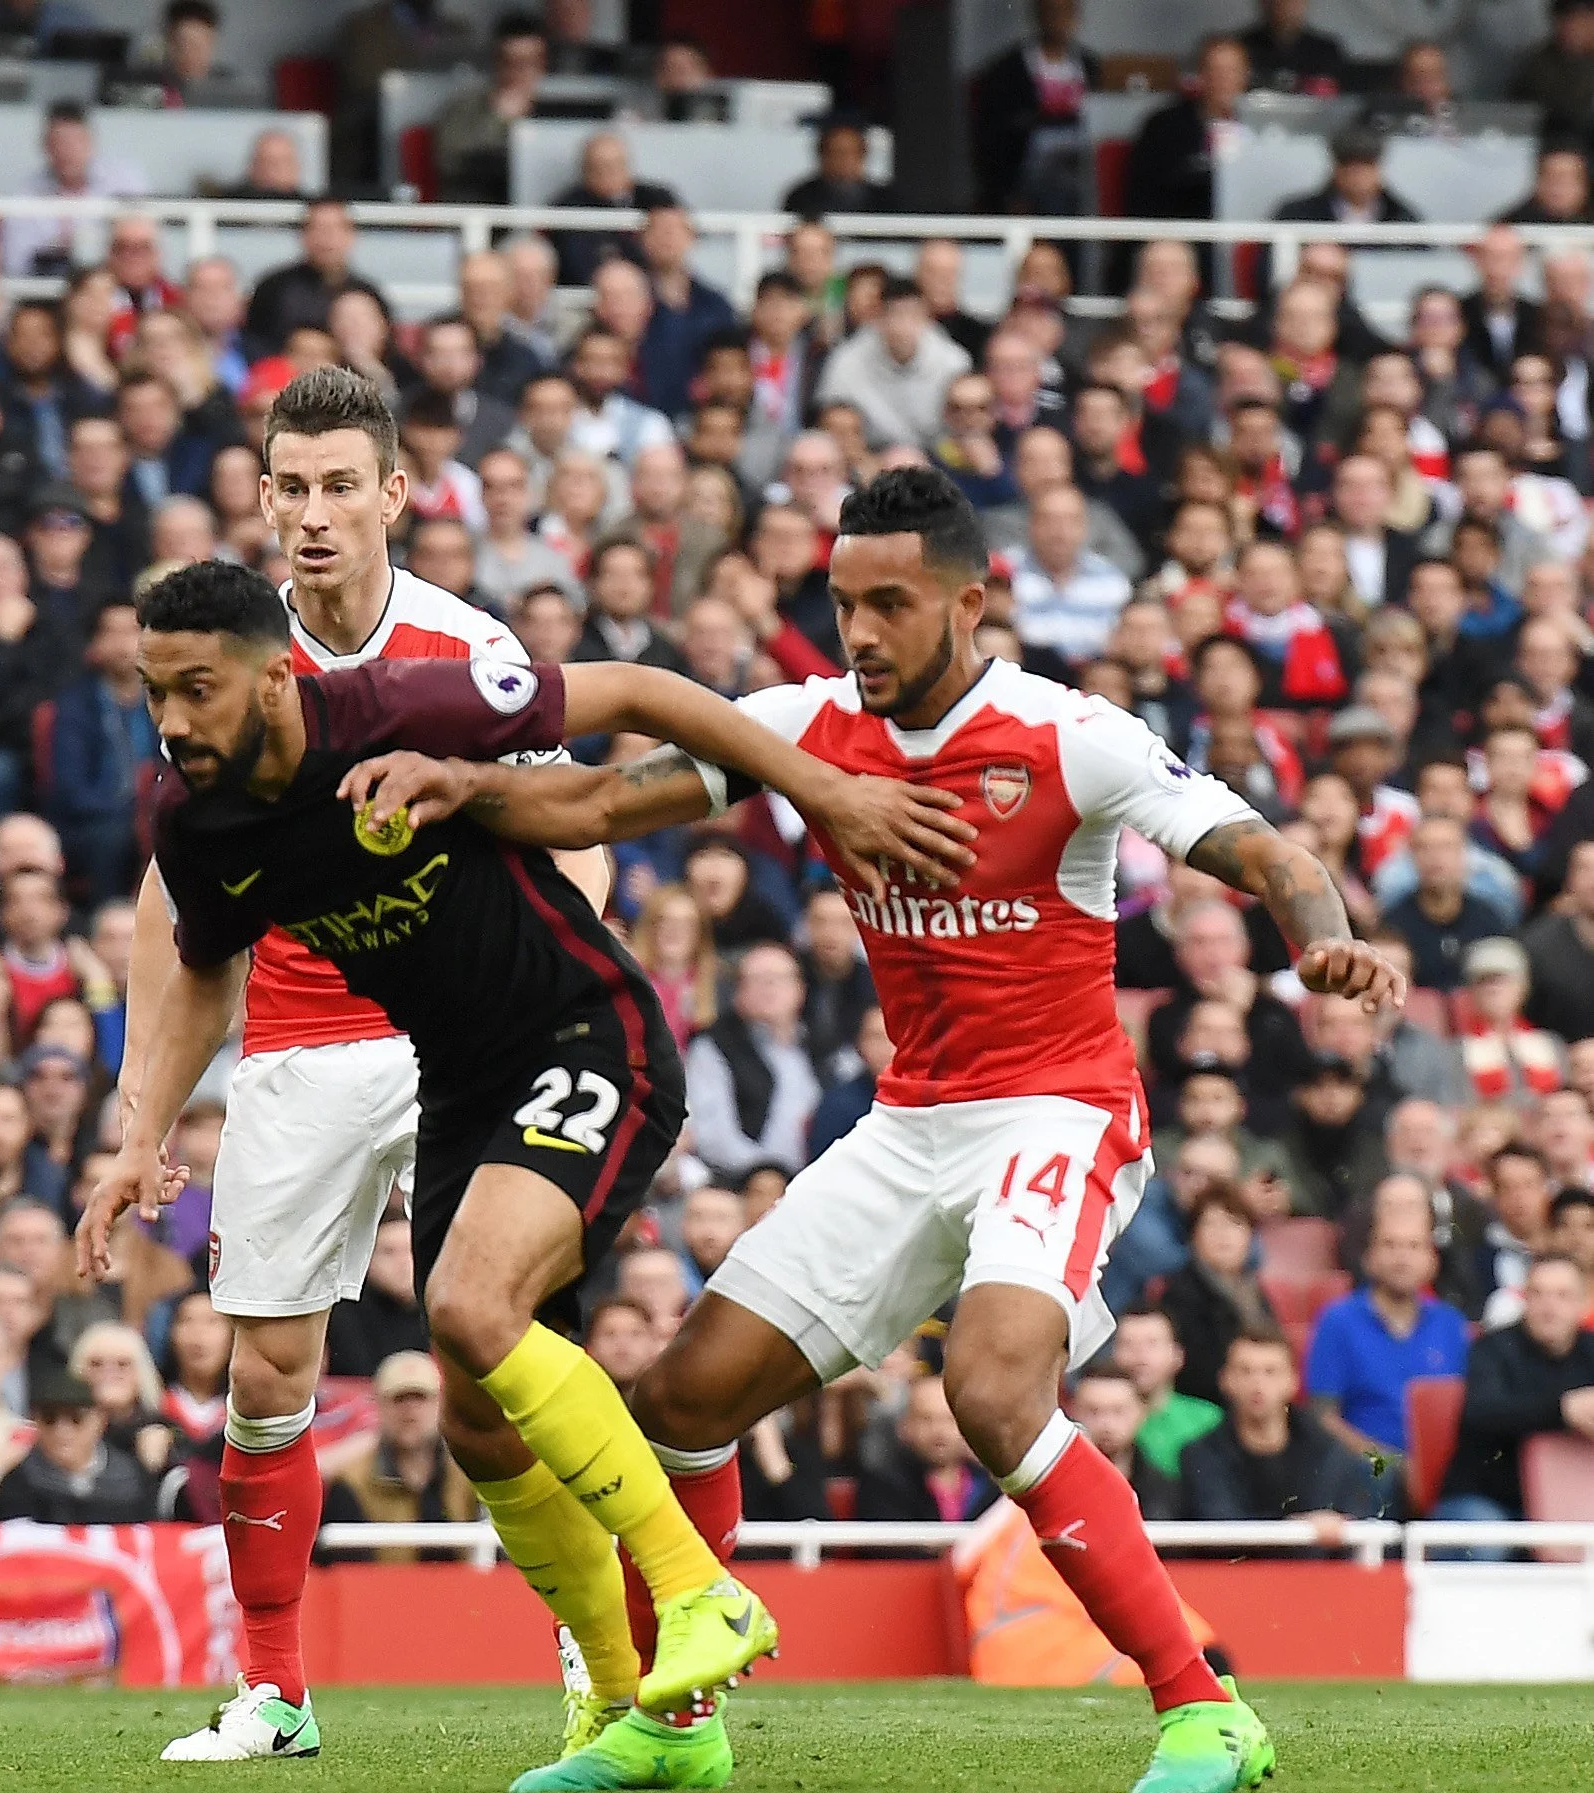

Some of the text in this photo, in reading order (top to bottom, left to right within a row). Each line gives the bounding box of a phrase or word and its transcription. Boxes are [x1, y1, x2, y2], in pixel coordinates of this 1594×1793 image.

[324, 909, 430, 951] RWAYS
[513, 1066, 620, 1154] 22
[995, 1151, 1070, 1210] 14
